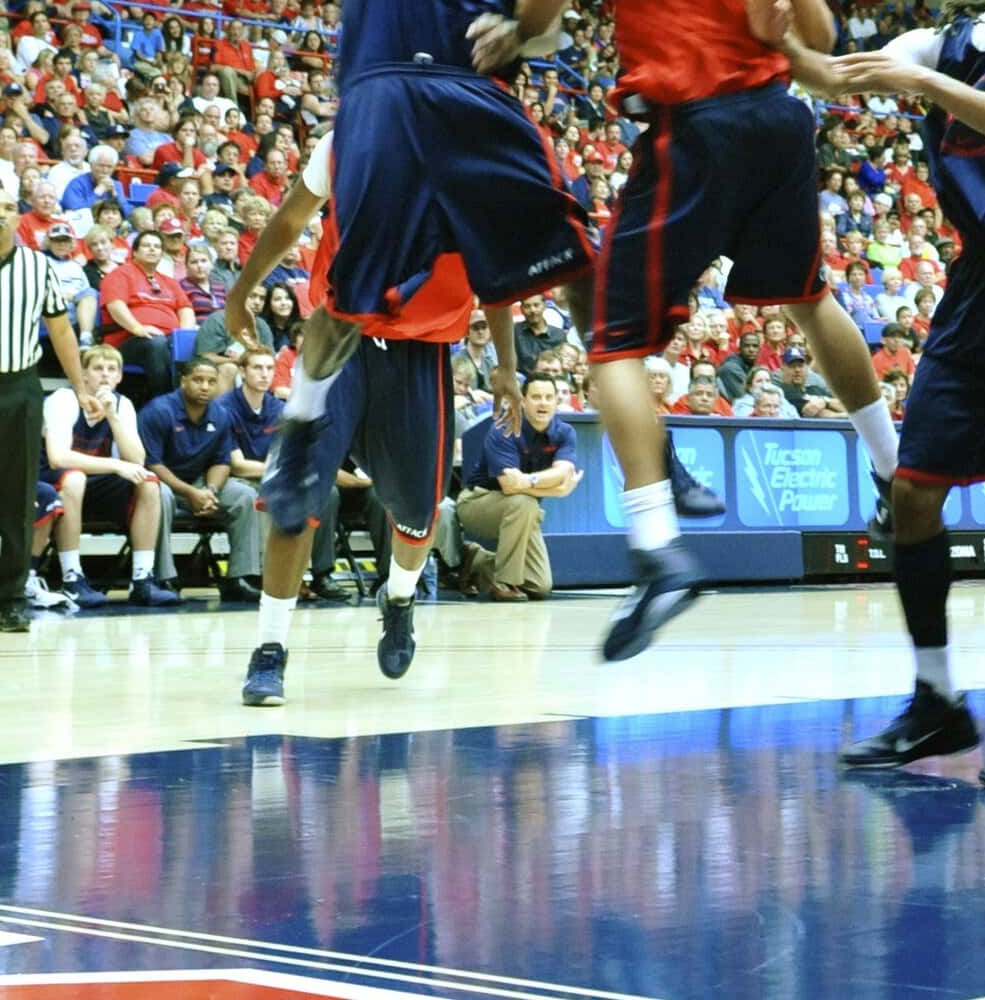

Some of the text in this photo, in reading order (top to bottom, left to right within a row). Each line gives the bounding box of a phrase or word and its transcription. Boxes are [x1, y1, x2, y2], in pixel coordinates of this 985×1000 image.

[763, 442, 823, 467] Tucson
[771, 466, 838, 489] Electric
[778, 489, 839, 513] Power
